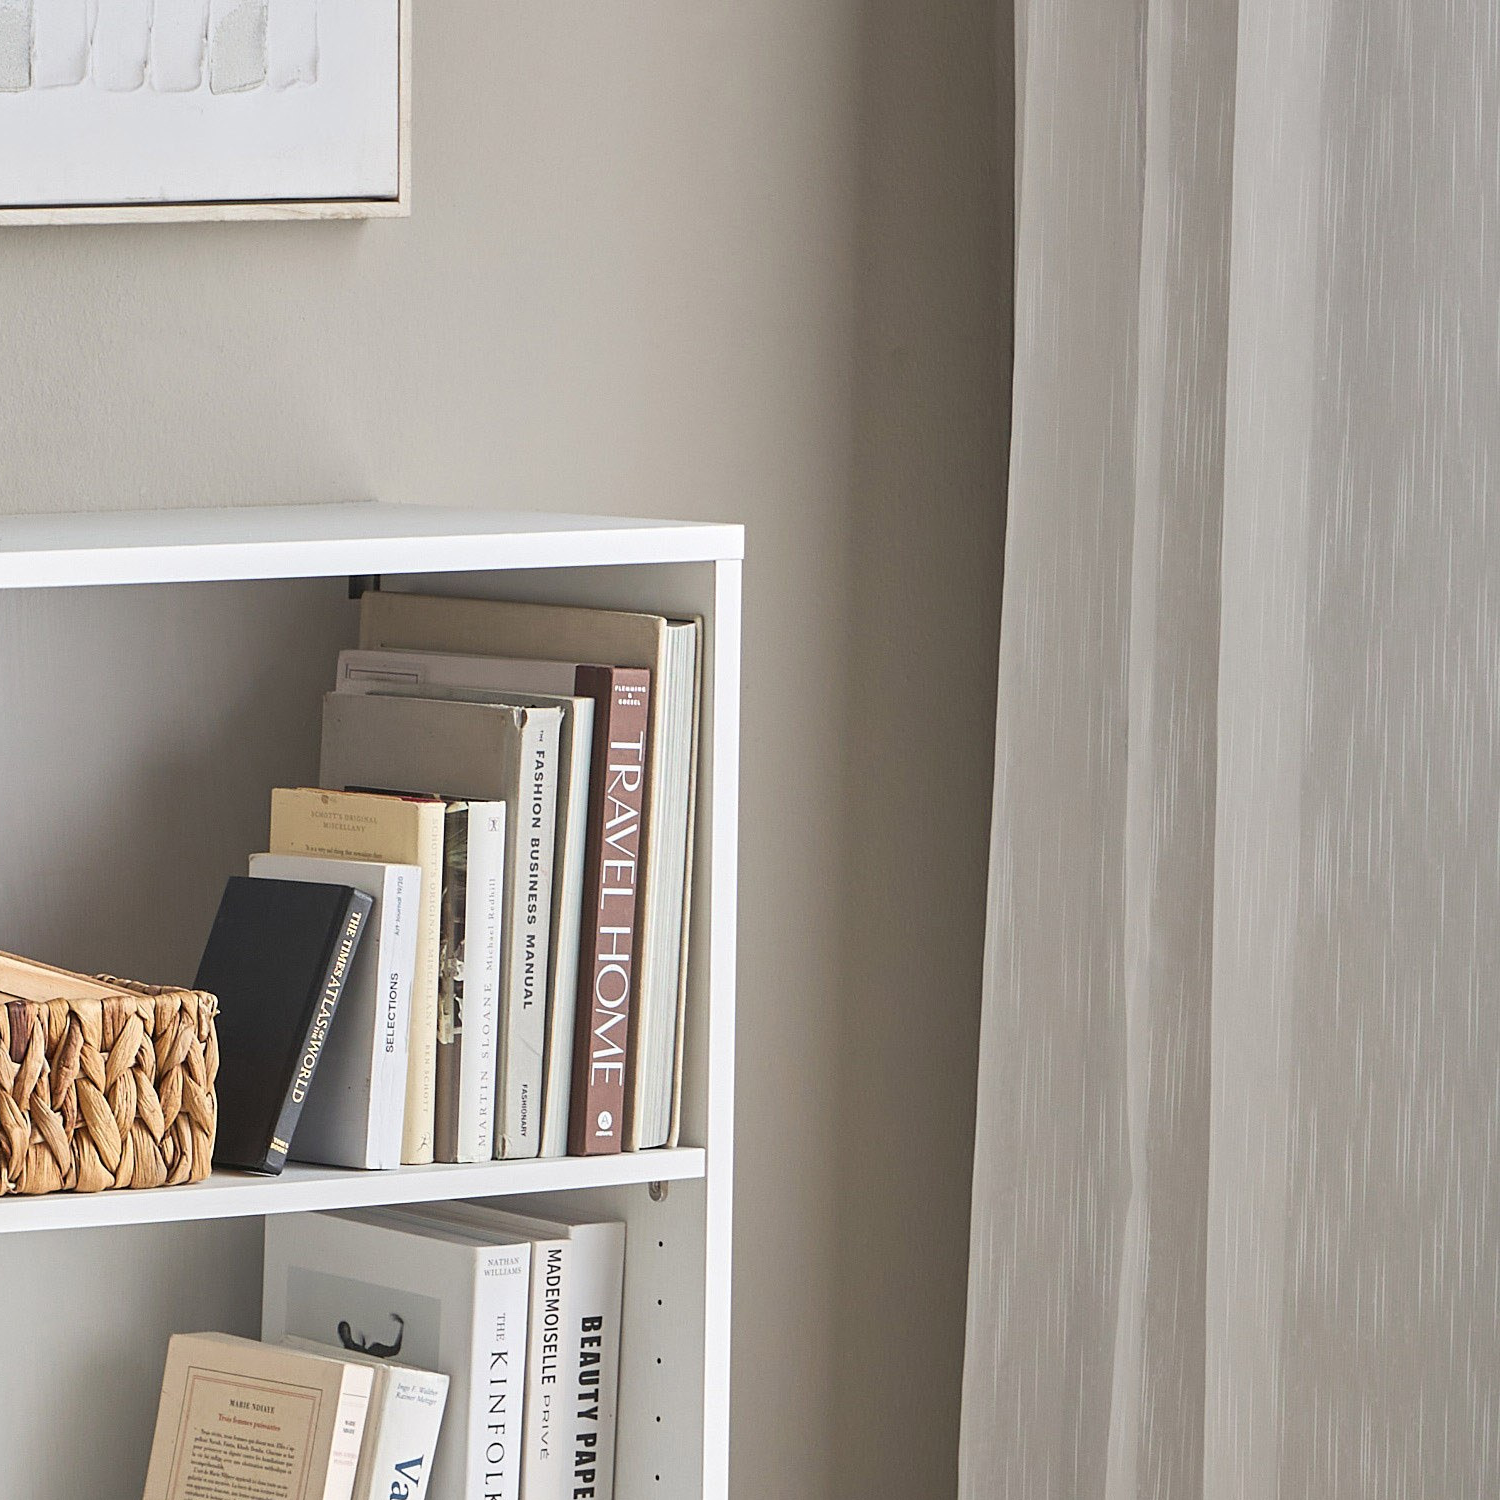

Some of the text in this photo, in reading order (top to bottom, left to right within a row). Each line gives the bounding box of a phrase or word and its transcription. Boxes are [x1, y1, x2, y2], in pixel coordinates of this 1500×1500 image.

[532, 750, 545, 828] FASHION
[601, 730, 644, 910] TRAVEL
[527, 838, 540, 925] BUSINESS
[346, 911, 362, 937] THE
[486, 925, 495, 971] Michael
[333, 938, 353, 978] TIMES
[523, 934, 536, 1010] MANUAL
[316, 975, 341, 1029] ATLAS
[386, 973, 399, 1053] SELECTIONS
[591, 926, 631, 1086] HOME
[292, 1040, 322, 1103] WORLD
[478, 983, 492, 1147] MARTIN SLOANE
[520, 1084, 528, 1137] FASHIONARY
[484, 1267, 522, 1277] WILLIAMS
[487, 1257, 520, 1266] NATHAN
[496, 1313, 505, 1342] THE
[541, 1249, 562, 1385] MADEMOISELLE
[577, 1315, 603, 1421] BEAUTY
[229, 1399, 250, 1410] MARIE
